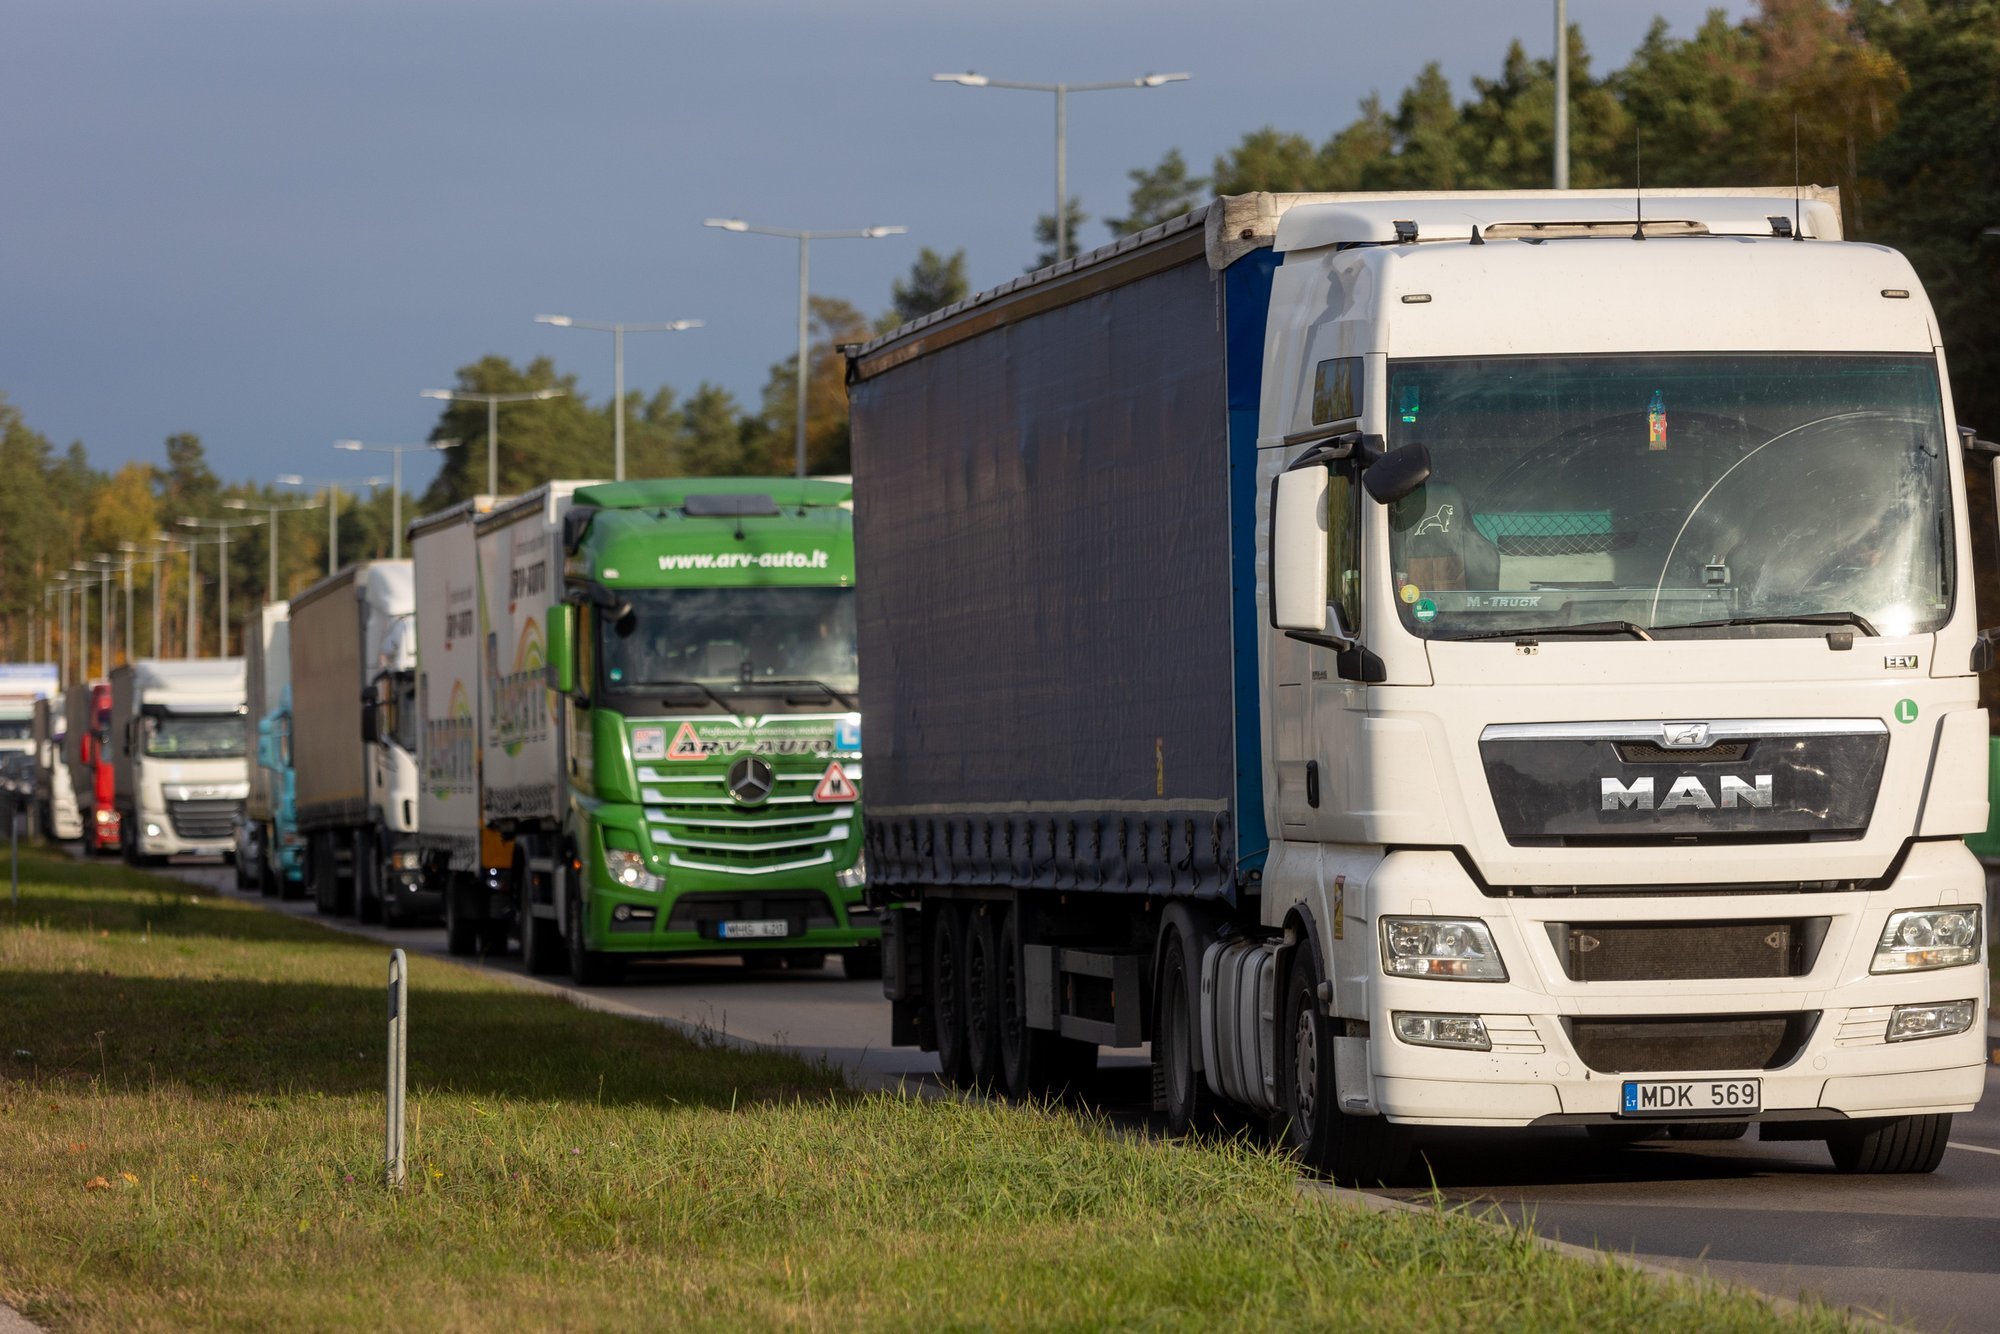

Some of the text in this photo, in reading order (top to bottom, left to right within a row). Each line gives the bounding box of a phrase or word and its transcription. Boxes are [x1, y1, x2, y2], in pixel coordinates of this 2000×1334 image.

[658, 550, 828, 570] www.arv-auto.lt
[1467, 596, 1542, 607] M-TRUCK
[1886, 656, 1917, 667] EEV
[1902, 701, 1914, 721] L
[677, 738, 834, 754] ARV-AUTO
[1601, 775, 1773, 811] MAN
[1641, 1084, 1754, 1107] MDK 569
